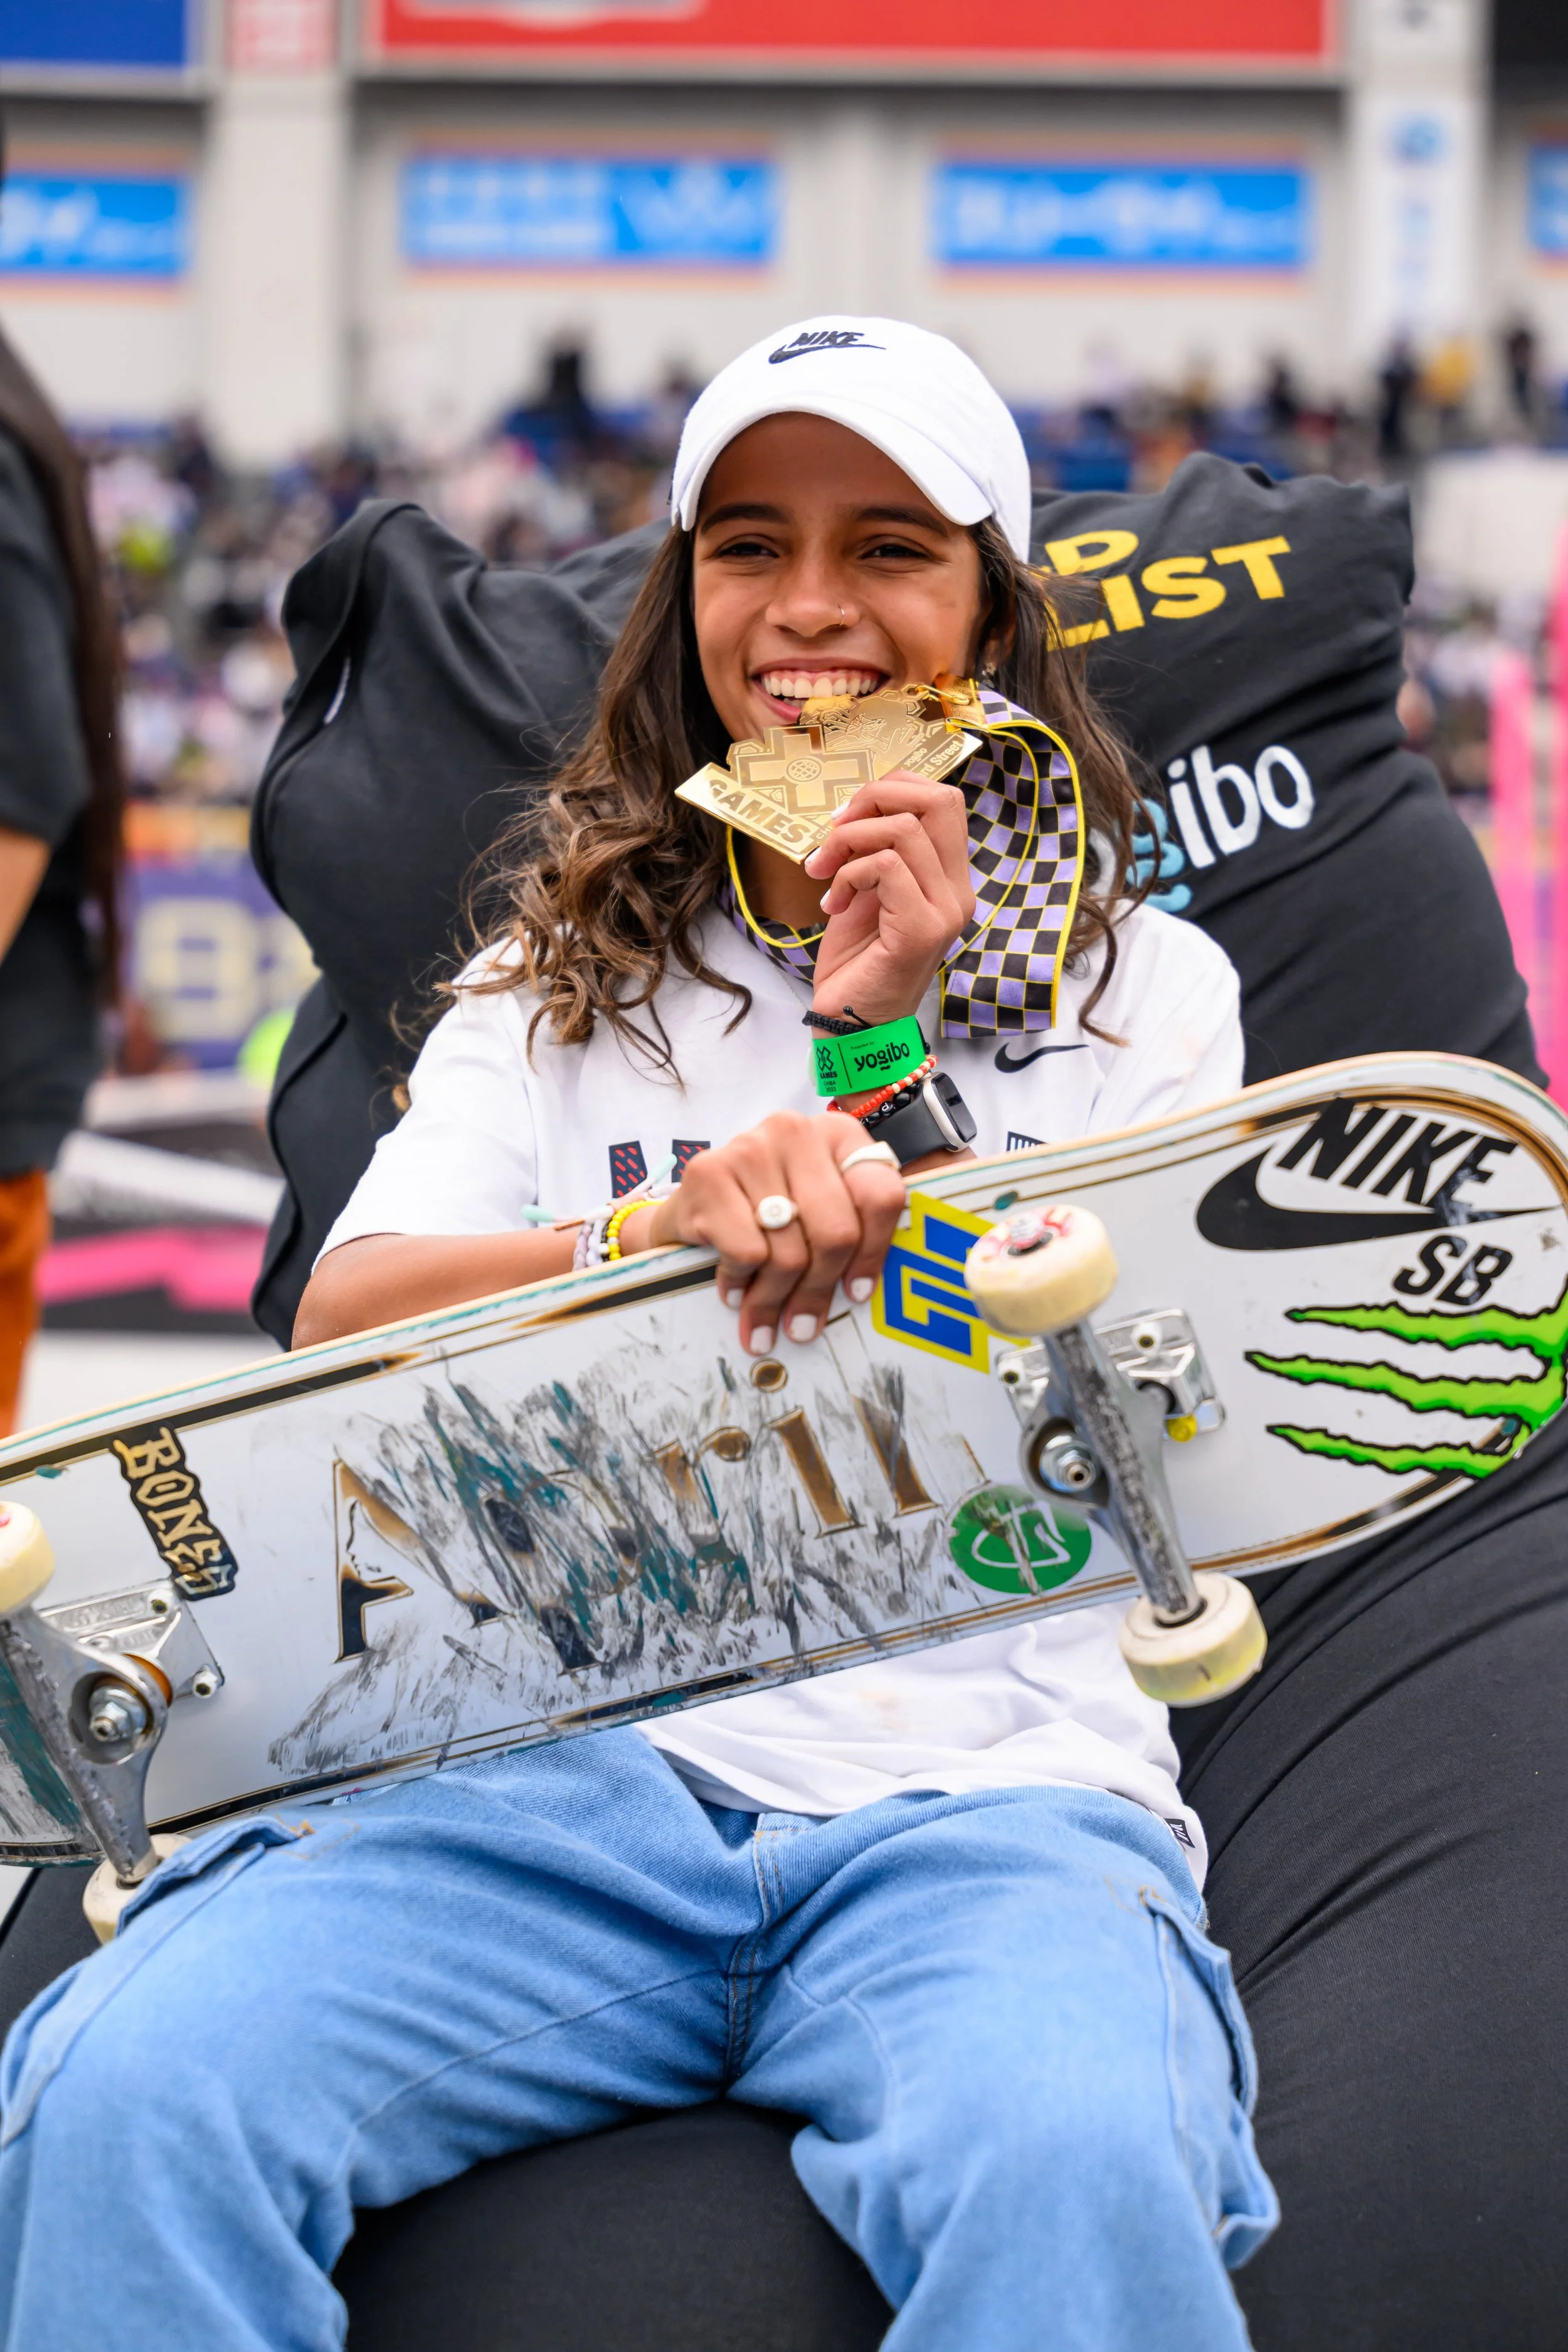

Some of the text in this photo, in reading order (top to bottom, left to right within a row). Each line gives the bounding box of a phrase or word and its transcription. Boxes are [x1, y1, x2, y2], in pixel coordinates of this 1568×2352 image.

[787, 331, 865, 349] NIKE
[930, 740, 964, 766] Street
[709, 779, 812, 844] GAMES
[820, 1071, 838, 1079] GAMES
[854, 1042, 910, 1072] yogibo
[1275, 1096, 1518, 1210] NIKE
[1392, 1234, 1513, 1306] SB
[112, 1426, 233, 1595] BONES
